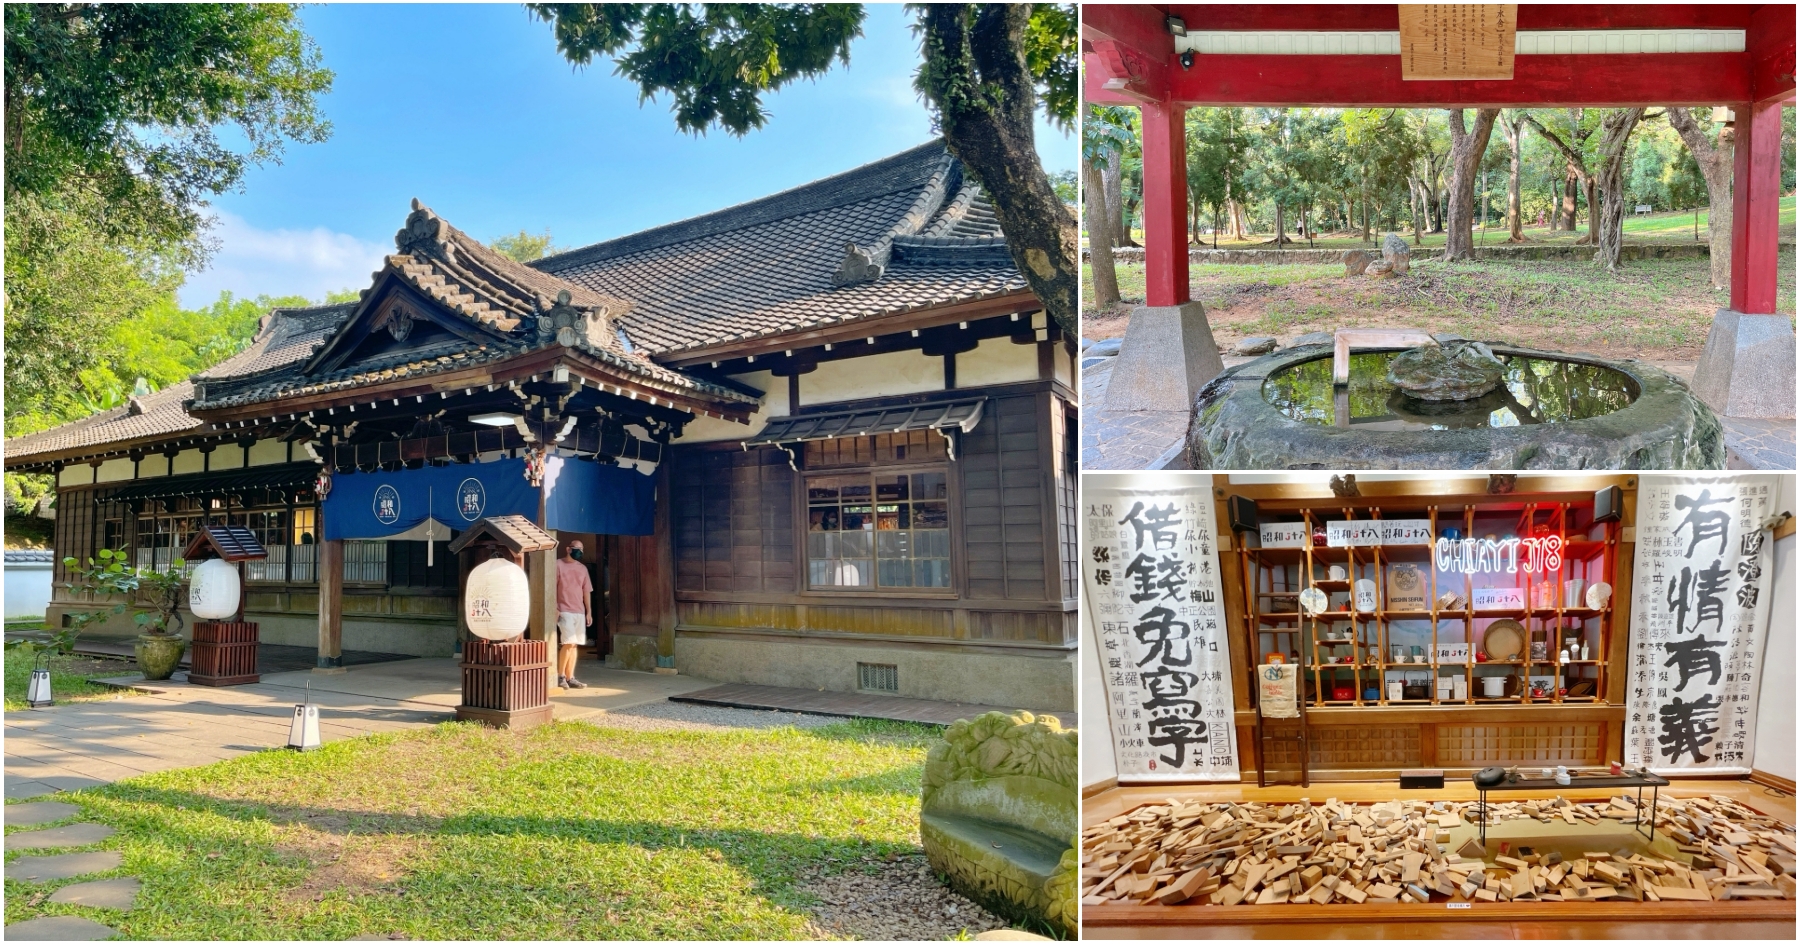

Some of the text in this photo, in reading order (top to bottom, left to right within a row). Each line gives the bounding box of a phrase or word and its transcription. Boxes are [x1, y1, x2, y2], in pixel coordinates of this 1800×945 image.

[1436, 535, 1562, 574] CHIAYI J18
[1190, 590, 1215, 603] 梅山
[1179, 605, 1217, 617] 中正公園
[1102, 621, 1129, 635] 東石
[1657, 489, 1735, 765] 有情有義
[1119, 501, 1209, 769] 借錢免寫字
[1110, 671, 1139, 687] 諸羅
[1119, 738, 1145, 748] 小火車
